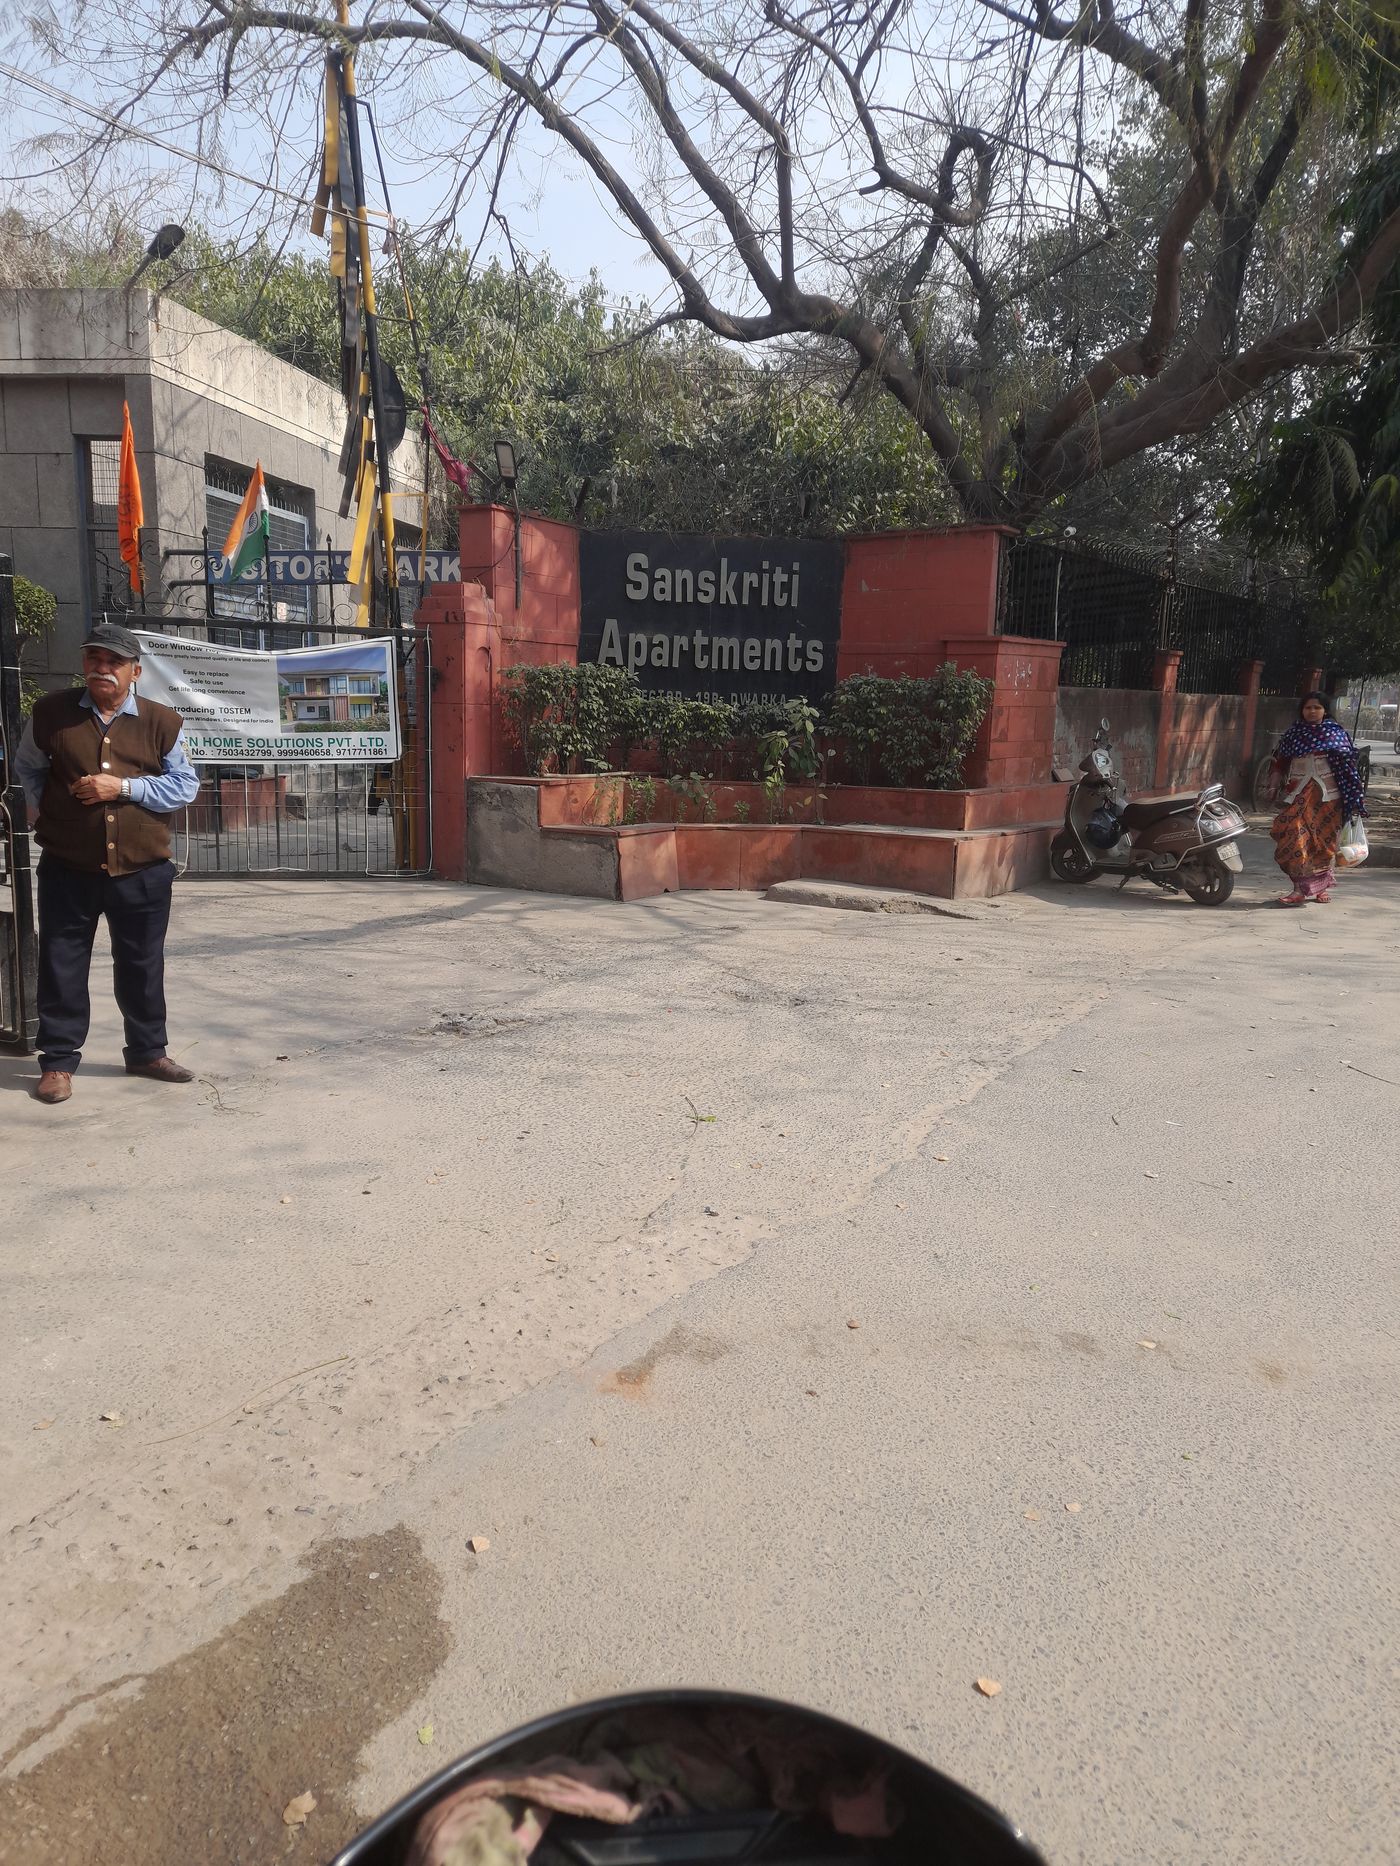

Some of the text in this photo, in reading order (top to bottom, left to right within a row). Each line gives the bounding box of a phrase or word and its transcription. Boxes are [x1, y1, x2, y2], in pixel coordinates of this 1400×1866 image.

[625, 553, 801, 607] Sanskriti
[148, 641, 168, 649] Door
[170, 643, 203, 652] Window
[598, 619, 824, 676] Apartments
[207, 688, 246, 696] convenience
[168, 706, 251, 715] ntroducing TOSTEM
[203, 737, 242, 748] HOME
[246, 738, 323, 749] SOLUTIONS
[328, 738, 355, 748] PVT.
[360, 737, 388, 748] LTD.
[191, 748, 208, 756] No.
[216, 748, 275, 757] 7503432799,
[277, 748, 334, 757] 9999460658,
[336, 748, 388, 756] 9717711861
